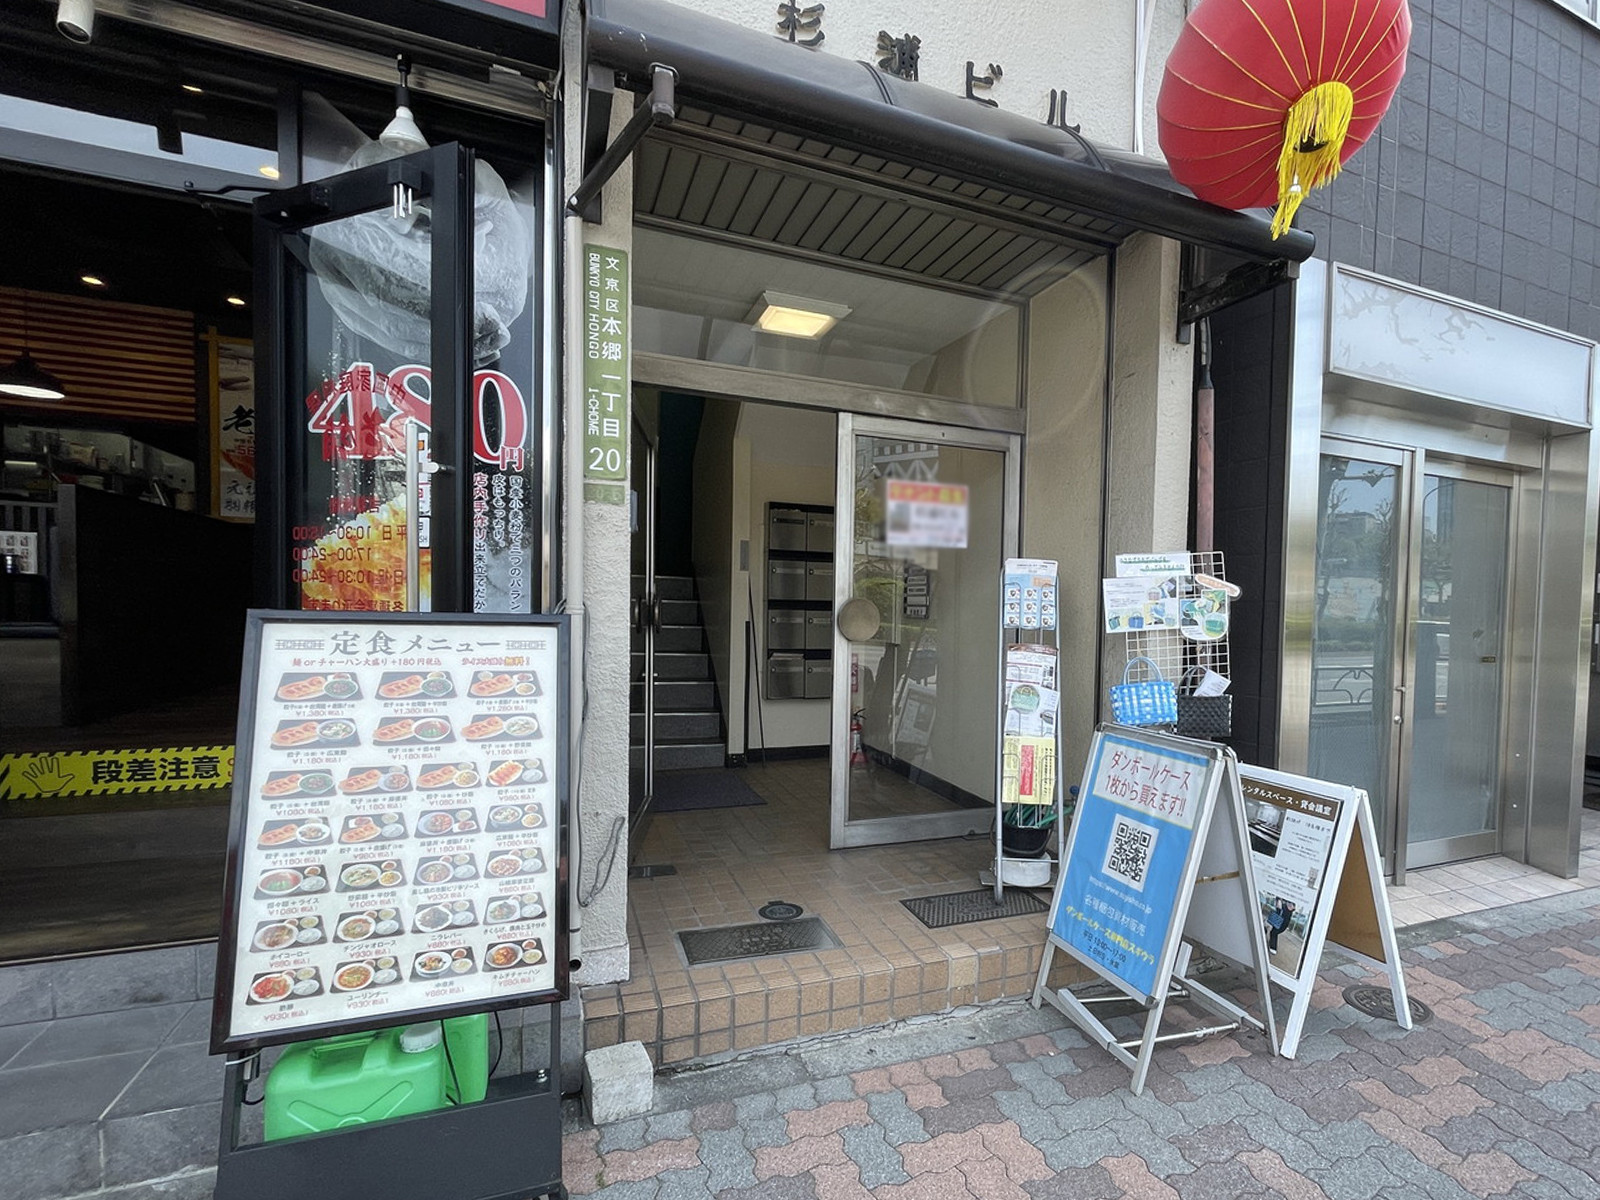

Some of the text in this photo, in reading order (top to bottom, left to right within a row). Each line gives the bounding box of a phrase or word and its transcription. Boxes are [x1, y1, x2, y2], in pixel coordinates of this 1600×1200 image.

[588, 252, 600, 436] BUNKYO CITY HONGO 1-CHOME
[602, 256, 622, 437] 文京区本郷一丁目
[589, 447, 621, 472] 20
[329, 630, 500, 656] 定食メニュー
[91, 755, 221, 785] 段差注意
[1111, 750, 1191, 791] ダンボールケース
